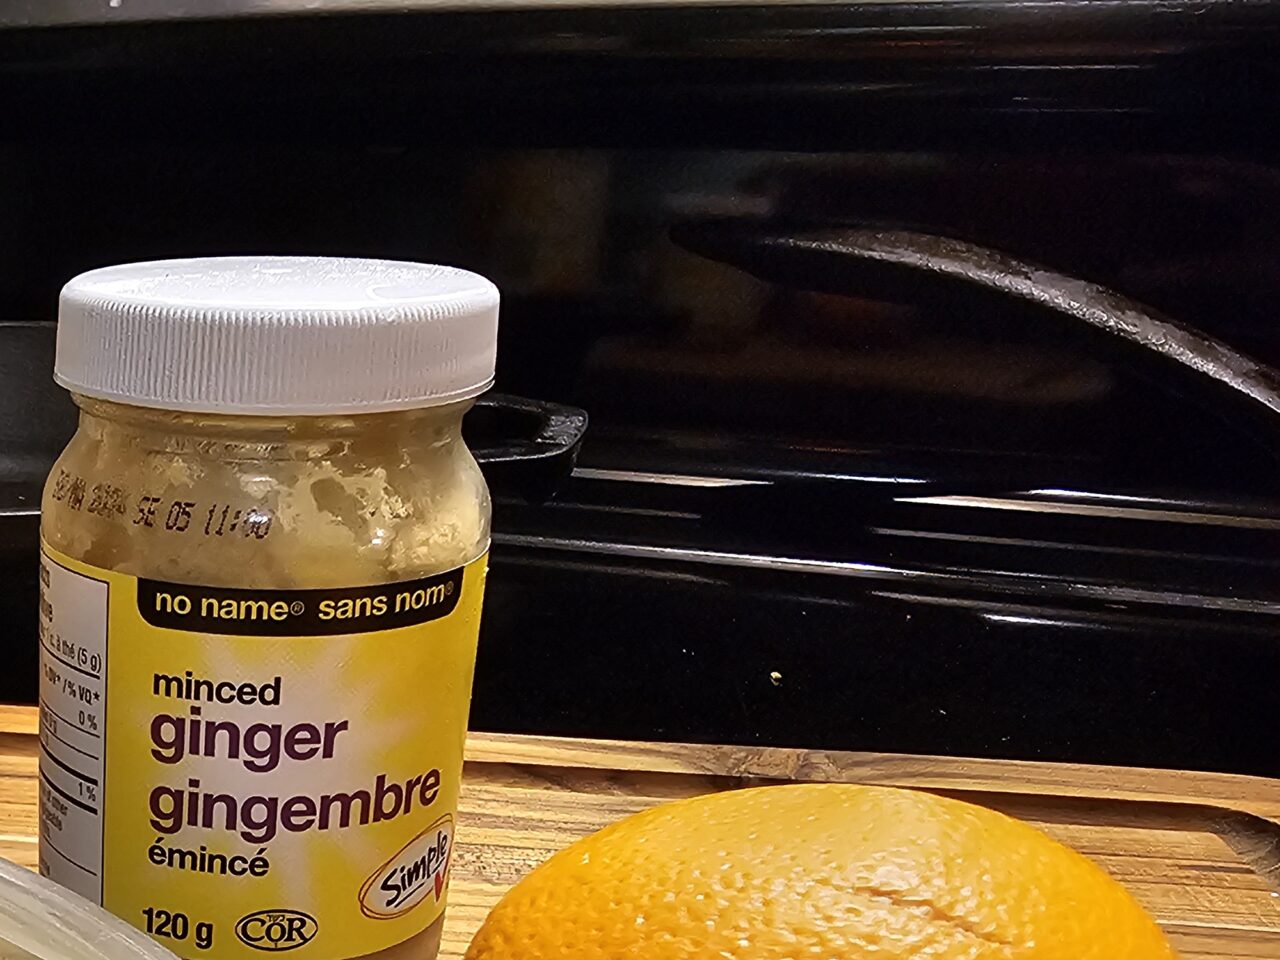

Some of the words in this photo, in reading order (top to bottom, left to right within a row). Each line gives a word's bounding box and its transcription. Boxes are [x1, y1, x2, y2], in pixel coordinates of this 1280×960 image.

[166, 501, 196, 532] 05
[155, 592, 192, 615] no
[318, 595, 388, 621] sans
[77, 646, 88, 667] (5
[90, 653, 101, 674] g)
[153, 671, 282, 706] minced
[79, 711, 85, 726] 0
[88, 714, 98, 731] %
[150, 705, 348, 773] ginger
[78, 781, 83, 796] 1
[86, 785, 96, 802] %
[149, 768, 441, 844] gingembre
[148, 837, 270, 877] émincé
[380, 830, 448, 907] Simple
[142, 907, 188, 940] 120
[196, 922, 213, 949] g
[241, 917, 309, 943] COR
